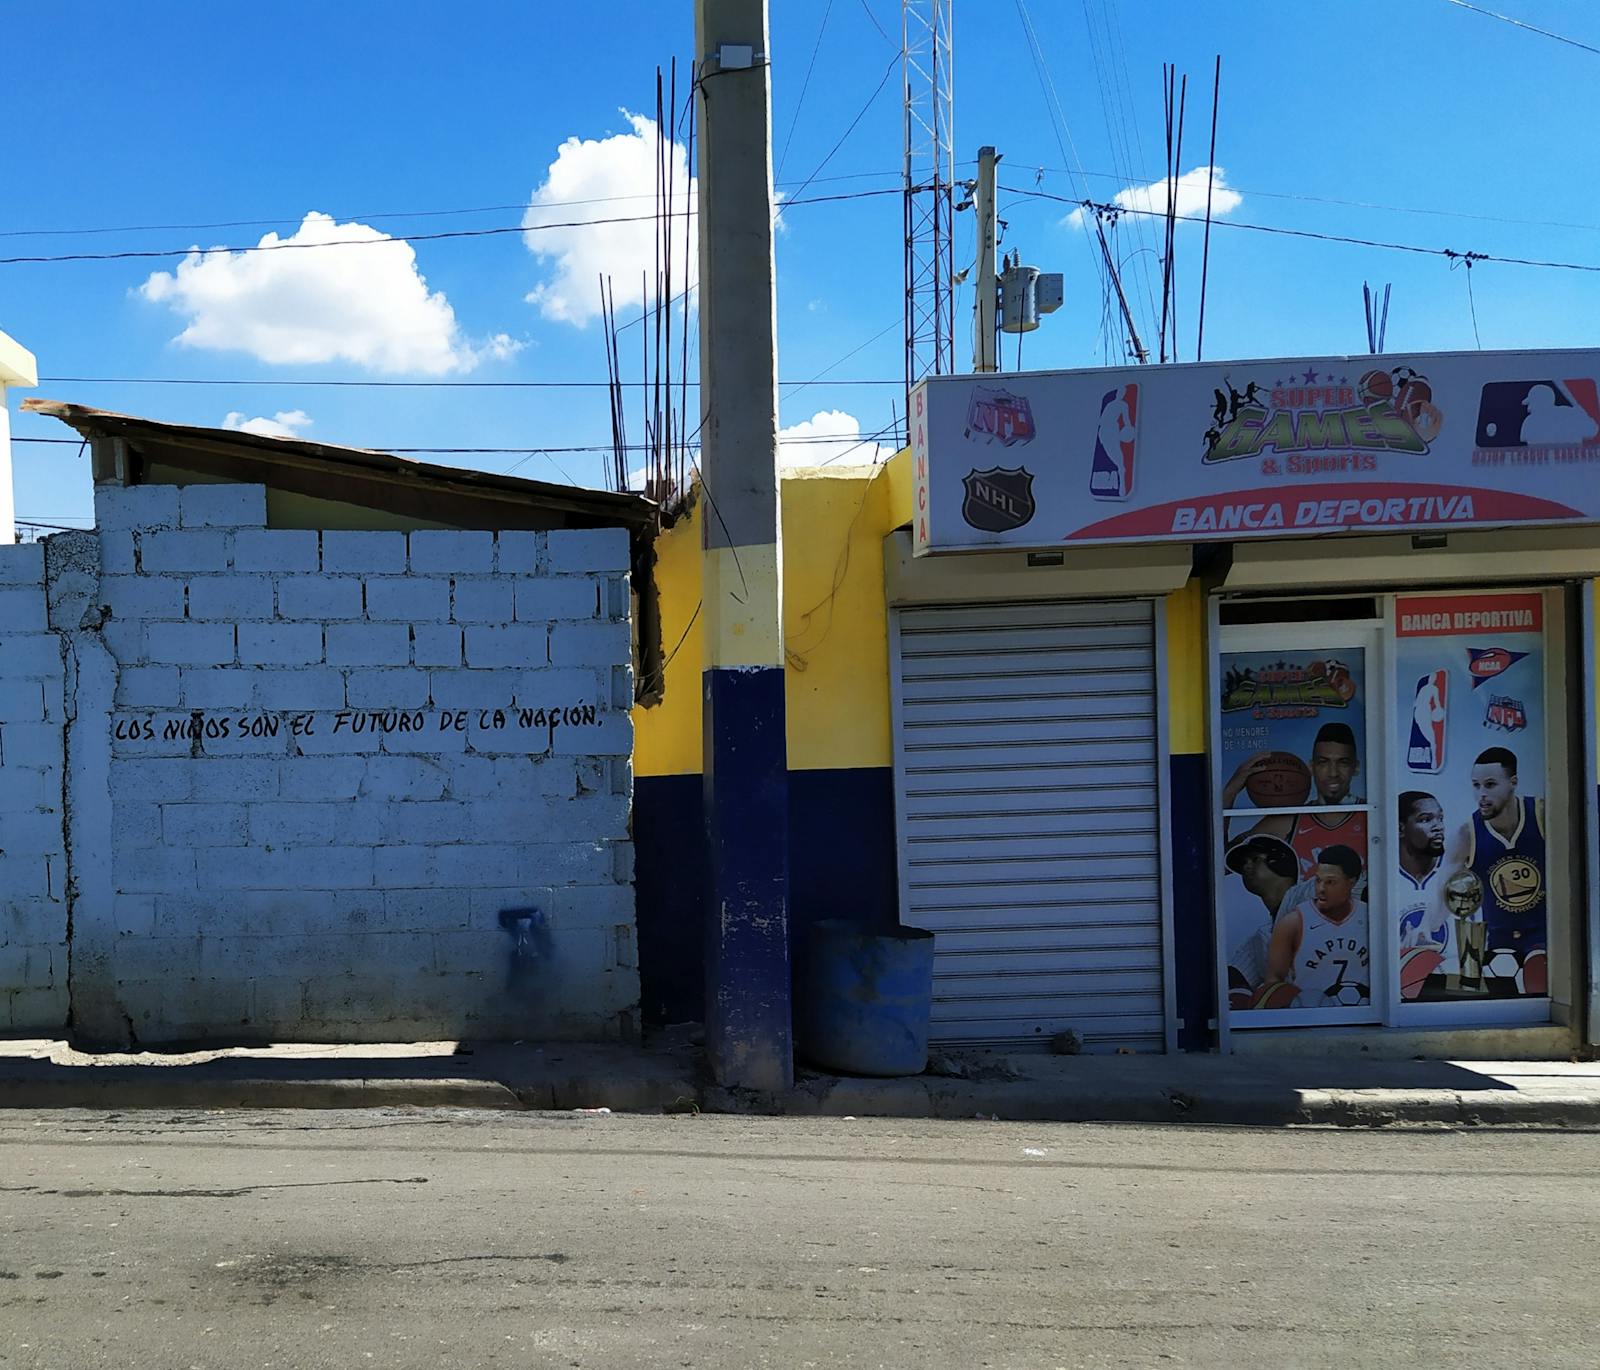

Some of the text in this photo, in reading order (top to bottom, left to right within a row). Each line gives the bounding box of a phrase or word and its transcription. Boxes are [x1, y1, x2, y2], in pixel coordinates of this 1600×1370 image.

[1270, 386, 1354, 409] SUPER
[975, 403, 1030, 442] NFL
[1203, 399, 1430, 465] GAMES
[915, 391, 927, 543] BANCA
[1262, 454, 1377, 476] & Sports
[975, 480, 1022, 518] NHL
[1171, 495, 1475, 532] BANCA DEPORTIVA
[1401, 609, 1534, 632] BANCA DEPORTIVA
[115, 719, 155, 740] LOS
[237, 715, 279, 738] SON
[291, 715, 315, 736] EL
[333, 711, 424, 734] FUTURO
[439, 710, 469, 732] DE
[479, 709, 507, 730] LA
[1488, 705, 1523, 727] NFL
[1222, 726, 1270, 737] NO MENORES
[1511, 867, 1530, 881] 30
[1332, 959, 1348, 984] 7
